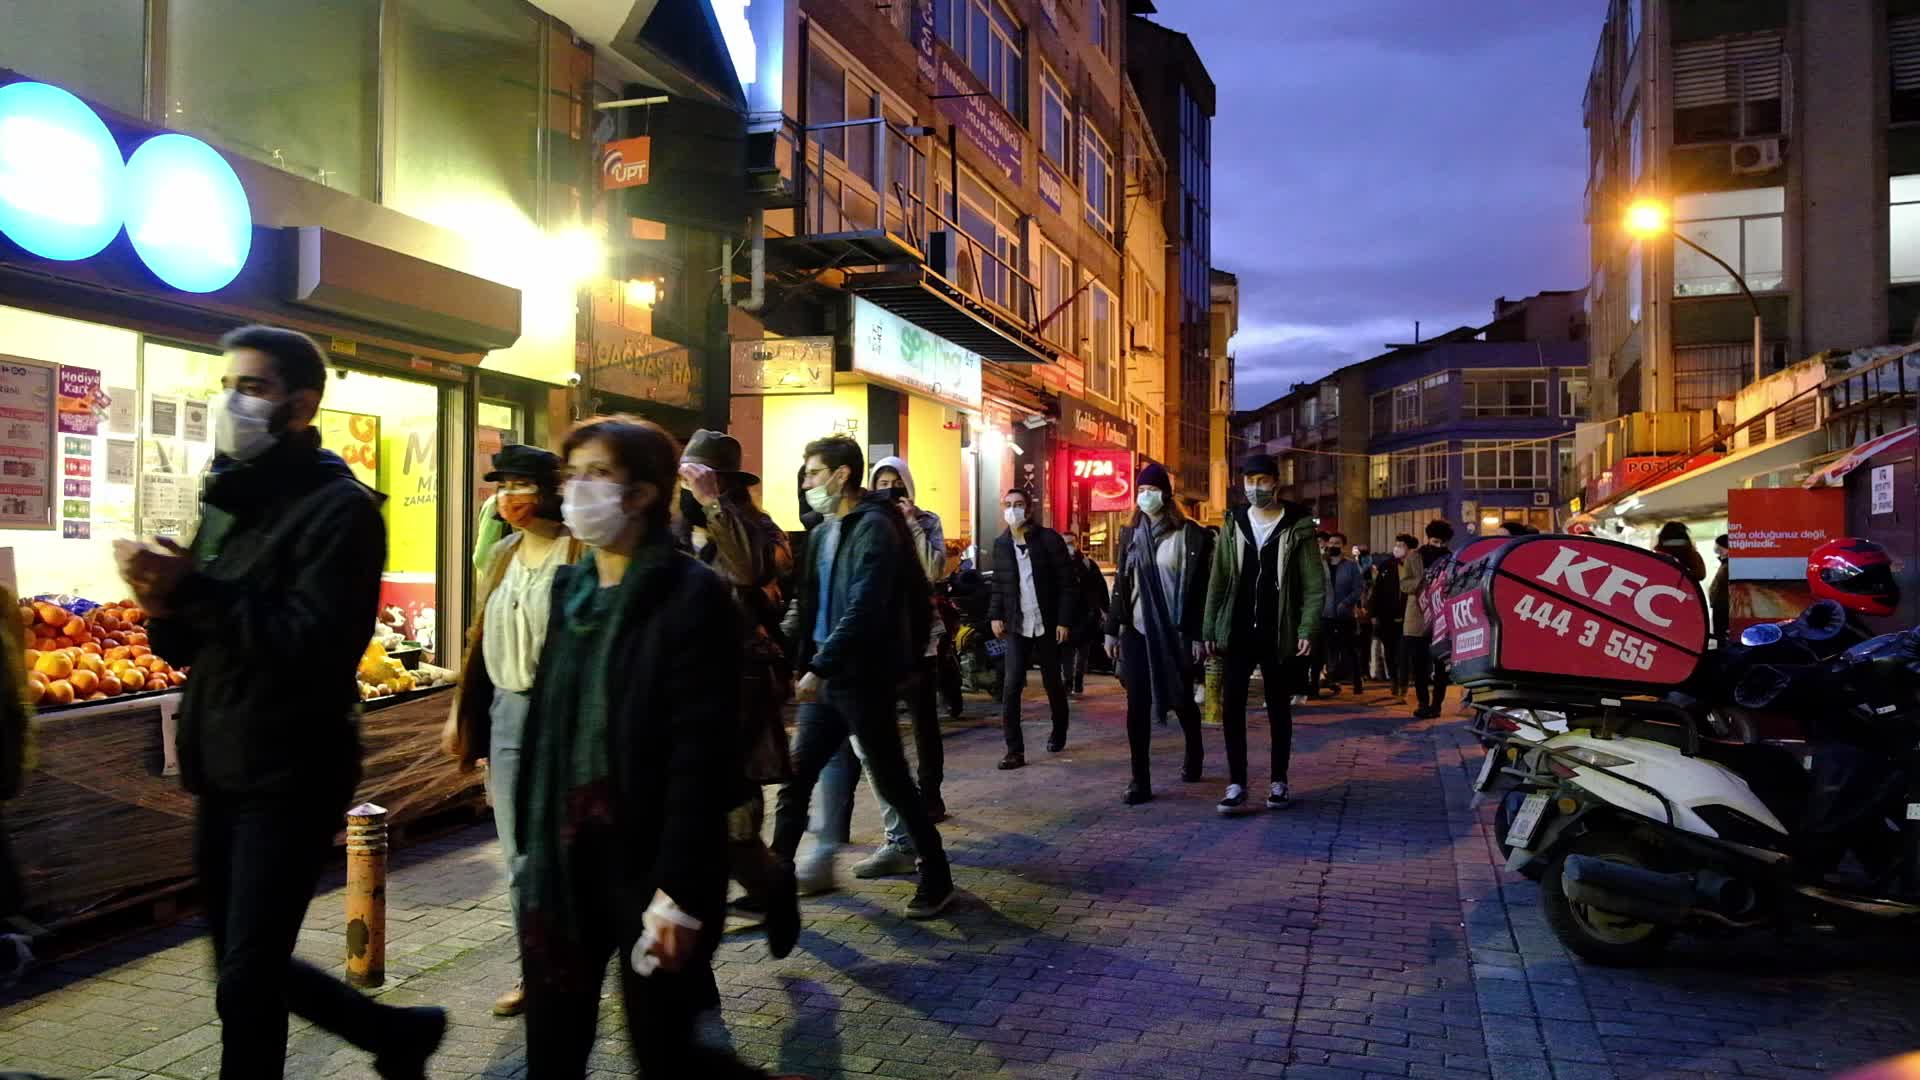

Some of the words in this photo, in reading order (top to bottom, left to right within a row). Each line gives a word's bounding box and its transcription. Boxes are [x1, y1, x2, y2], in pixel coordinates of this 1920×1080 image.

[616, 164, 646, 182] UPT
[1074, 459, 1113, 478] 7/24
[1536, 545, 1687, 628] KFC
[1452, 597, 1478, 629] KFC
[1513, 594, 1572, 637] 444
[1578, 619, 1600, 647] 3
[1604, 630, 1657, 670] 555
